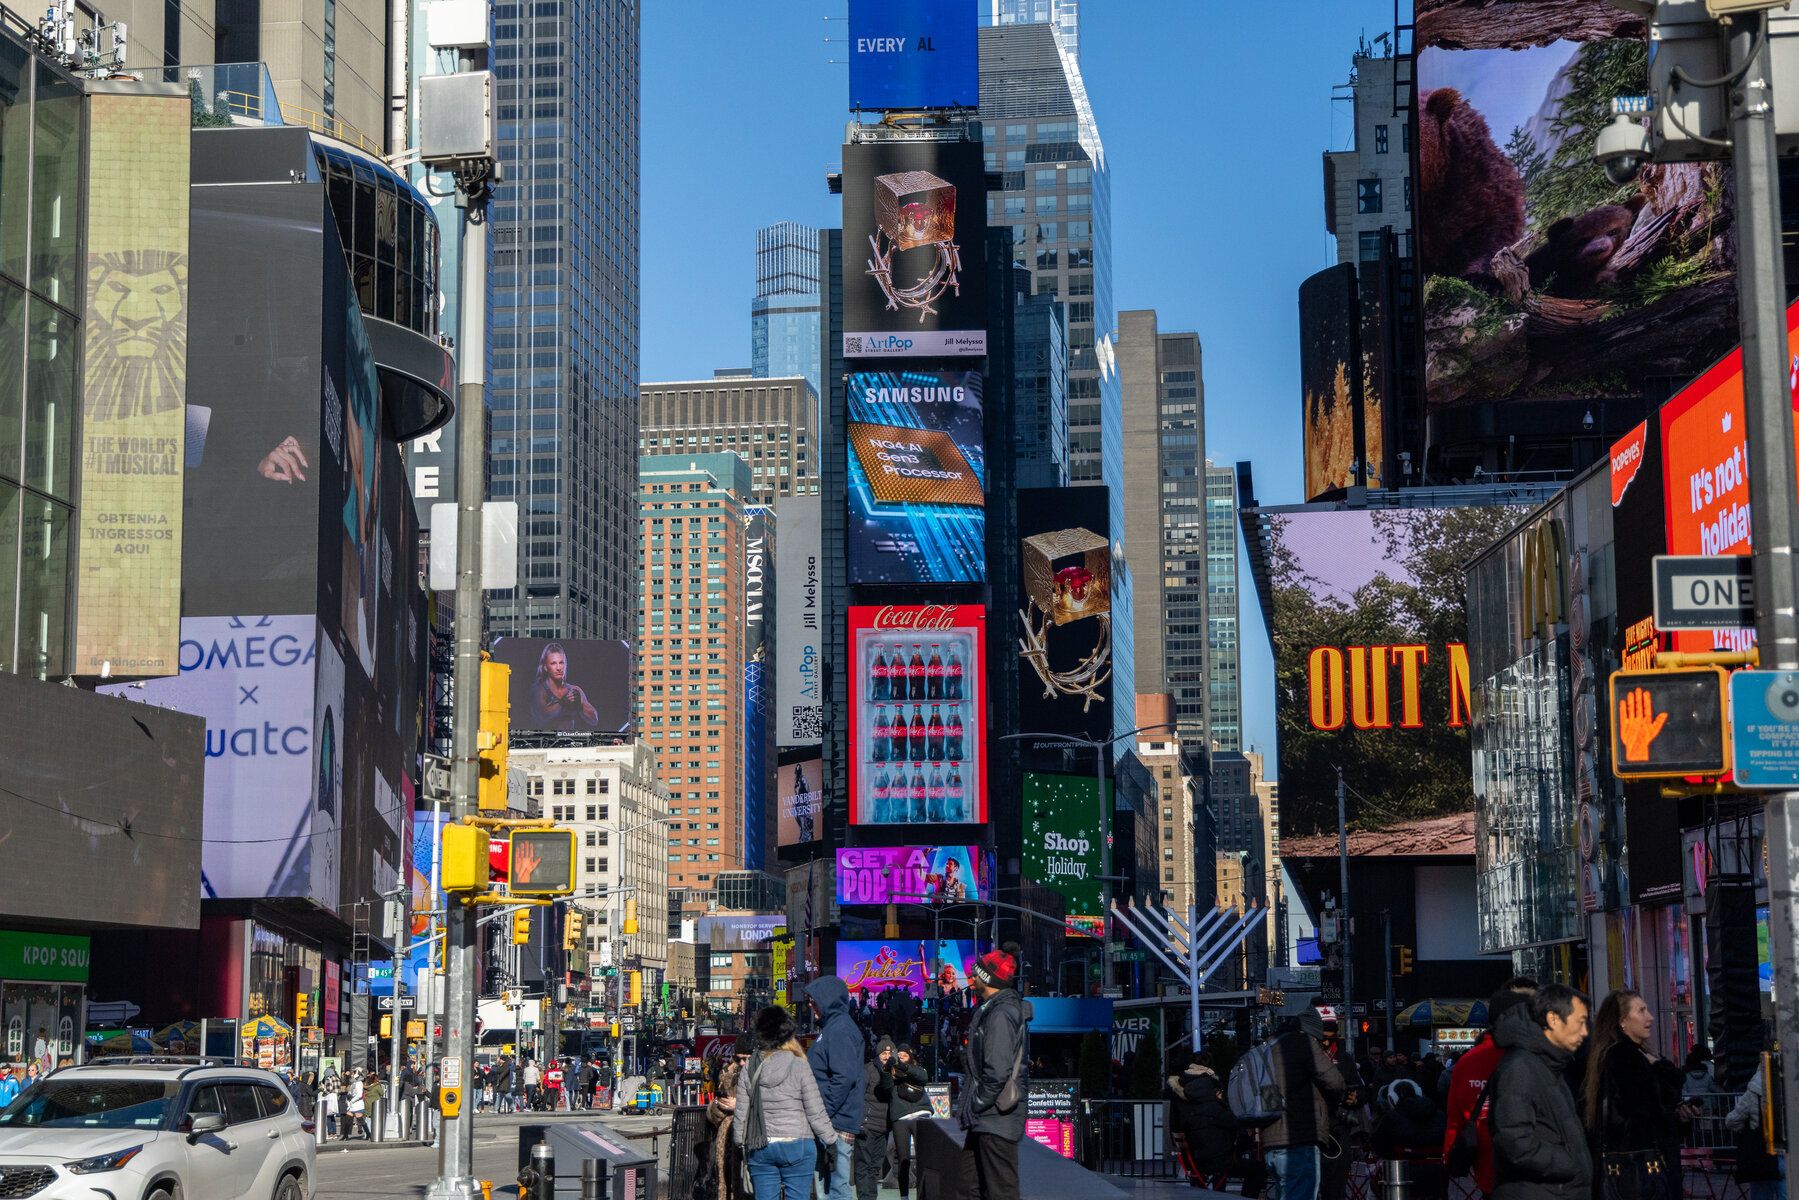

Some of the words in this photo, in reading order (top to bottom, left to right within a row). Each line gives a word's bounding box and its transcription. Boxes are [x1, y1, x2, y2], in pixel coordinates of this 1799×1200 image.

[857, 37, 906, 53] EVERY
[917, 37, 935, 52] AL
[1616, 96, 1654, 113] NYPD
[865, 335, 913, 351] ArtPop
[945, 338, 954, 346] Jill
[955, 337, 983, 346] Melyssa
[865, 386, 965, 403] SAMSUNG
[88, 436, 115, 454] THE
[117, 436, 178, 455] WORLD'S
[869, 438, 905, 450] NQ4
[908, 443, 924, 453] AI
[104, 453, 179, 476] MUSICAL
[876, 451, 920, 464] Gen3
[882, 464, 963, 480] Processor
[1690, 467, 1713, 514] It's
[1715, 445, 1742, 498] not
[97, 513, 168, 525] OBTENHA
[91, 527, 173, 540] INGRESSOS
[113, 543, 150, 555] AQUI
[803, 556, 818, 608] Melyssa
[1690, 578, 1754, 606] ONE
[803, 613, 818, 630] Jill
[873, 604, 958, 632] Coca-Cola
[799, 645, 814, 699] ArtPop
[1307, 643, 1429, 731] OUT
[1749, 750, 1782, 758] TIPPING
[782, 790, 822, 806] VANDERBILT
[782, 802, 822, 818] UNIVERSITY
[1043, 832, 1090, 855] Shop
[841, 850, 898, 868] GET
[905, 849, 930, 868] A
[1047, 856, 1089, 880] Holiday,
[843, 868, 887, 902] POP
[23, 945, 58, 967] KPOP
[1129, 952, 1138, 960] 45
[380, 969, 388, 977] 45
[844, 957, 923, 990] Juliet
